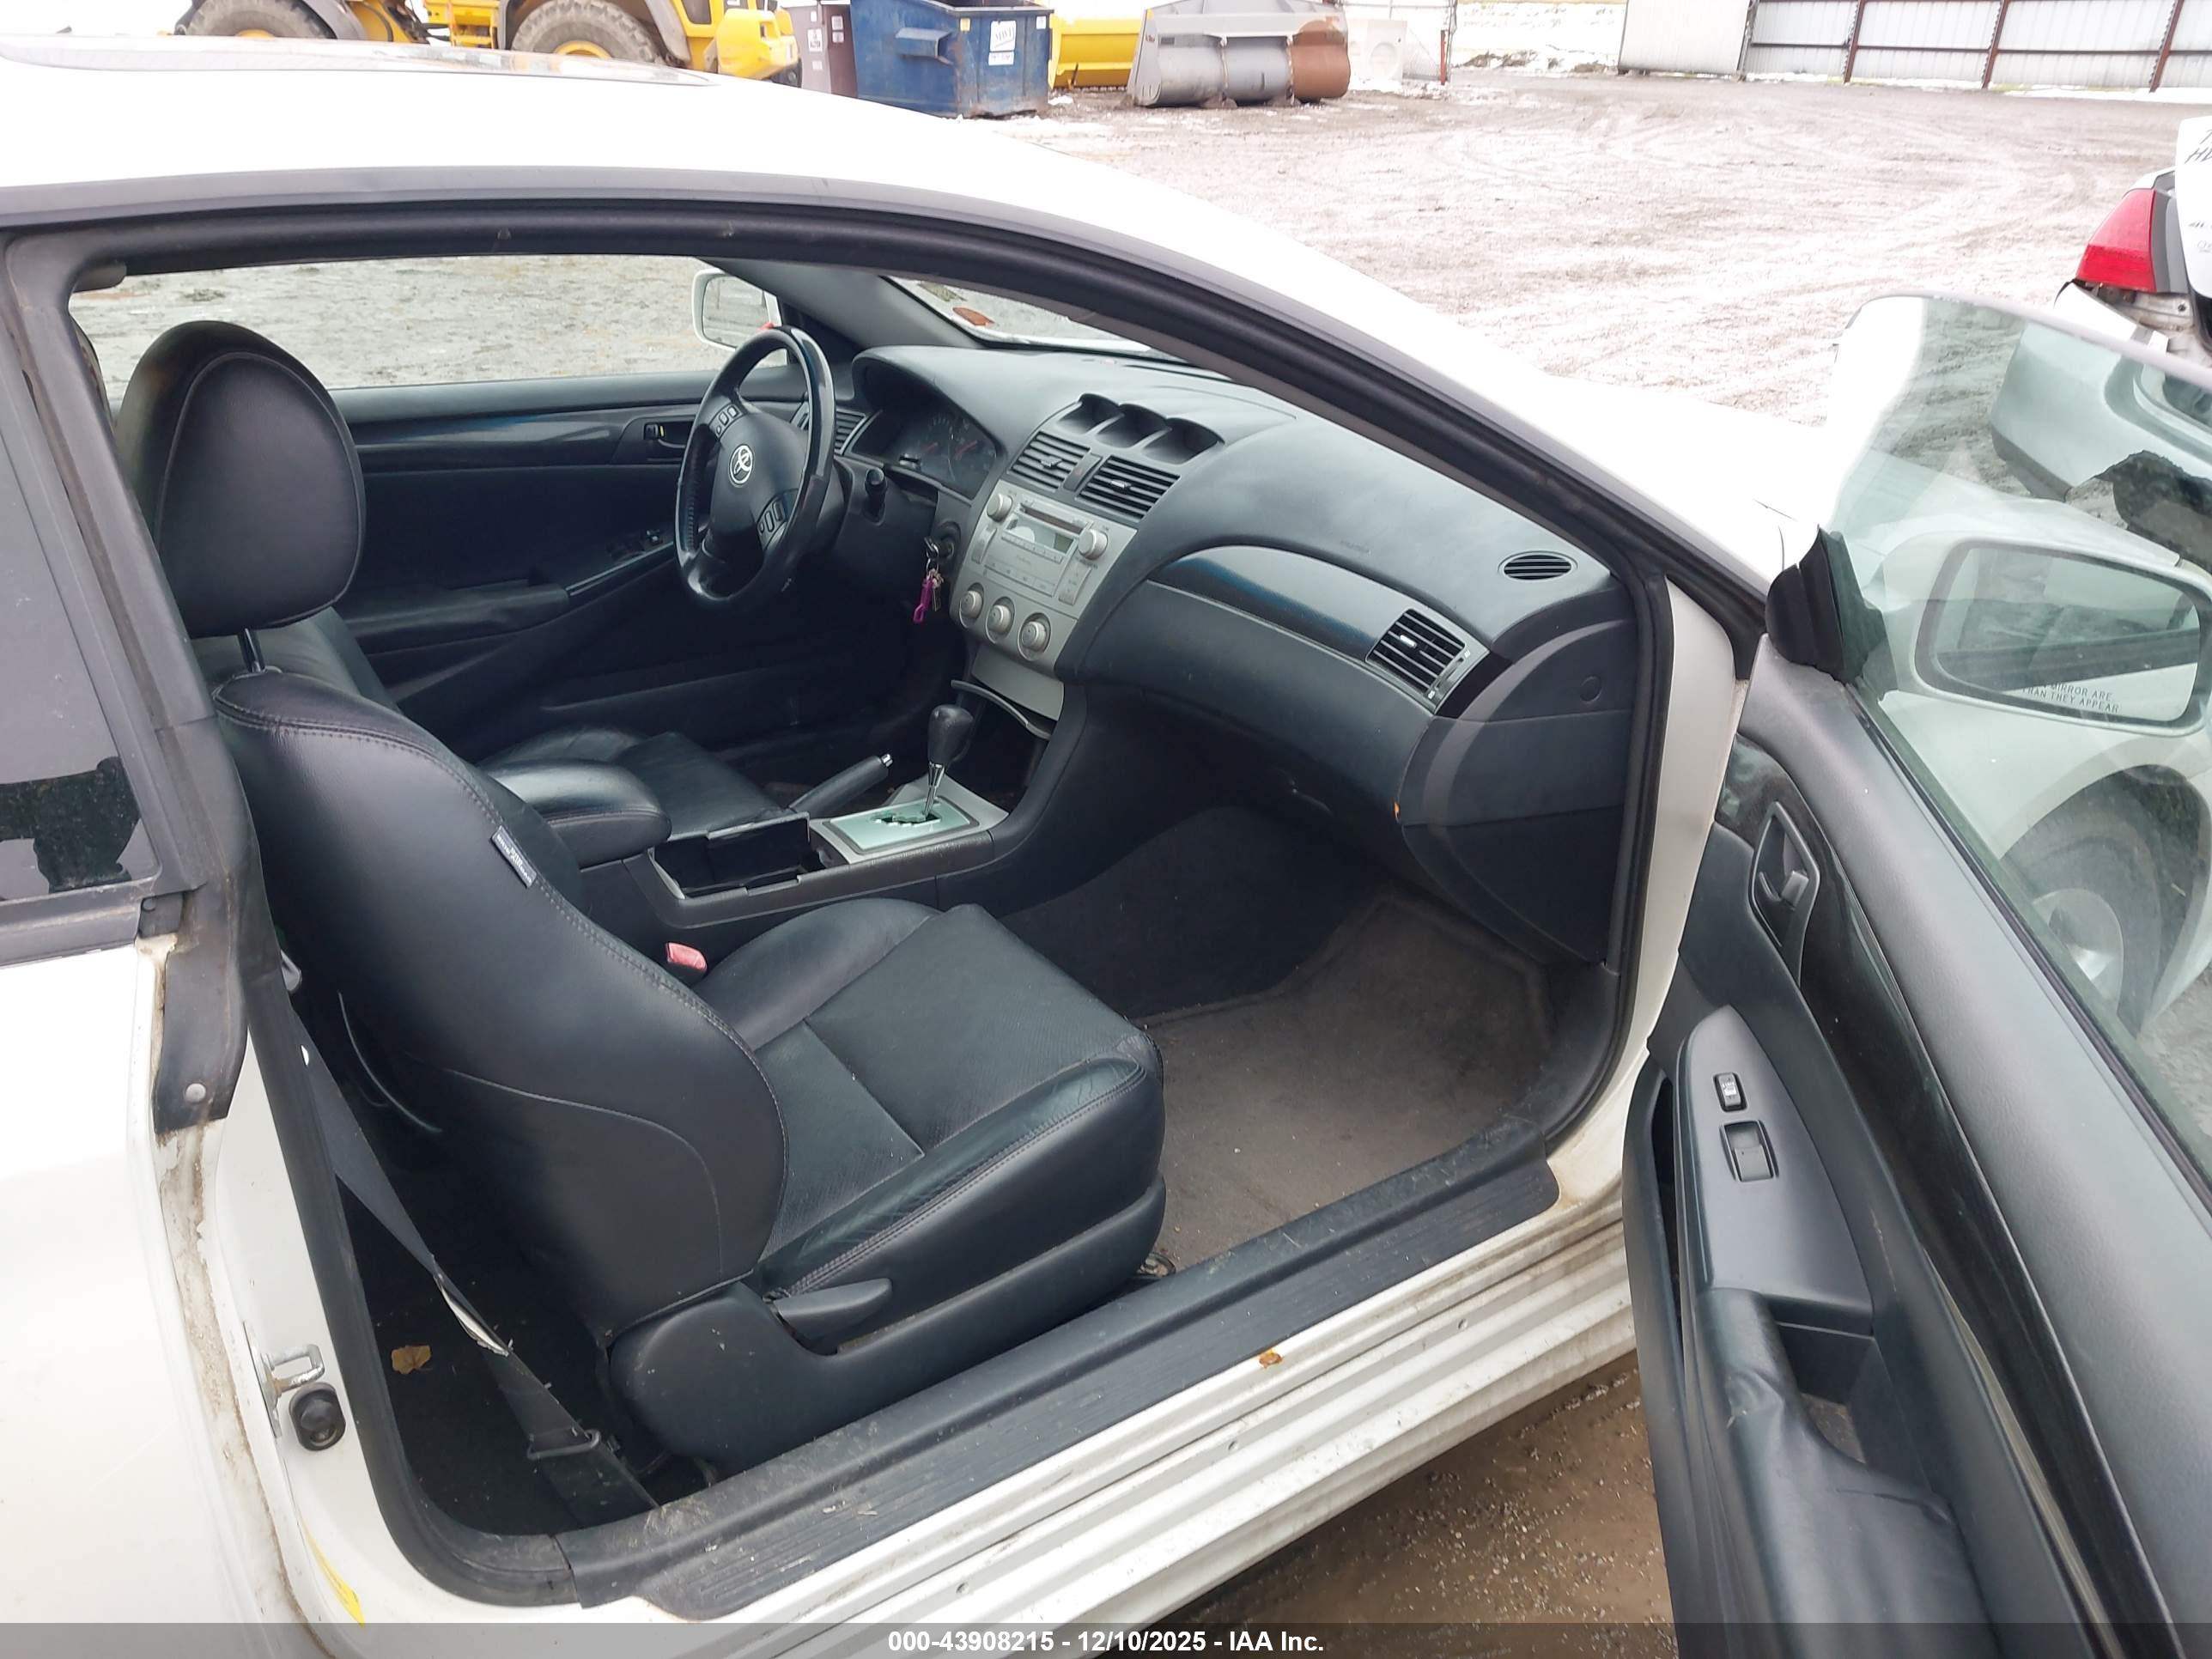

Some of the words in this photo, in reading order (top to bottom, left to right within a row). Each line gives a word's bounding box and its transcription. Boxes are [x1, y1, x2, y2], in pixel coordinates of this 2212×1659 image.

[2051, 691, 2075, 704] THEY
[2079, 697, 2119, 714] APPEAR
[2092, 690, 2112, 702] ARE
